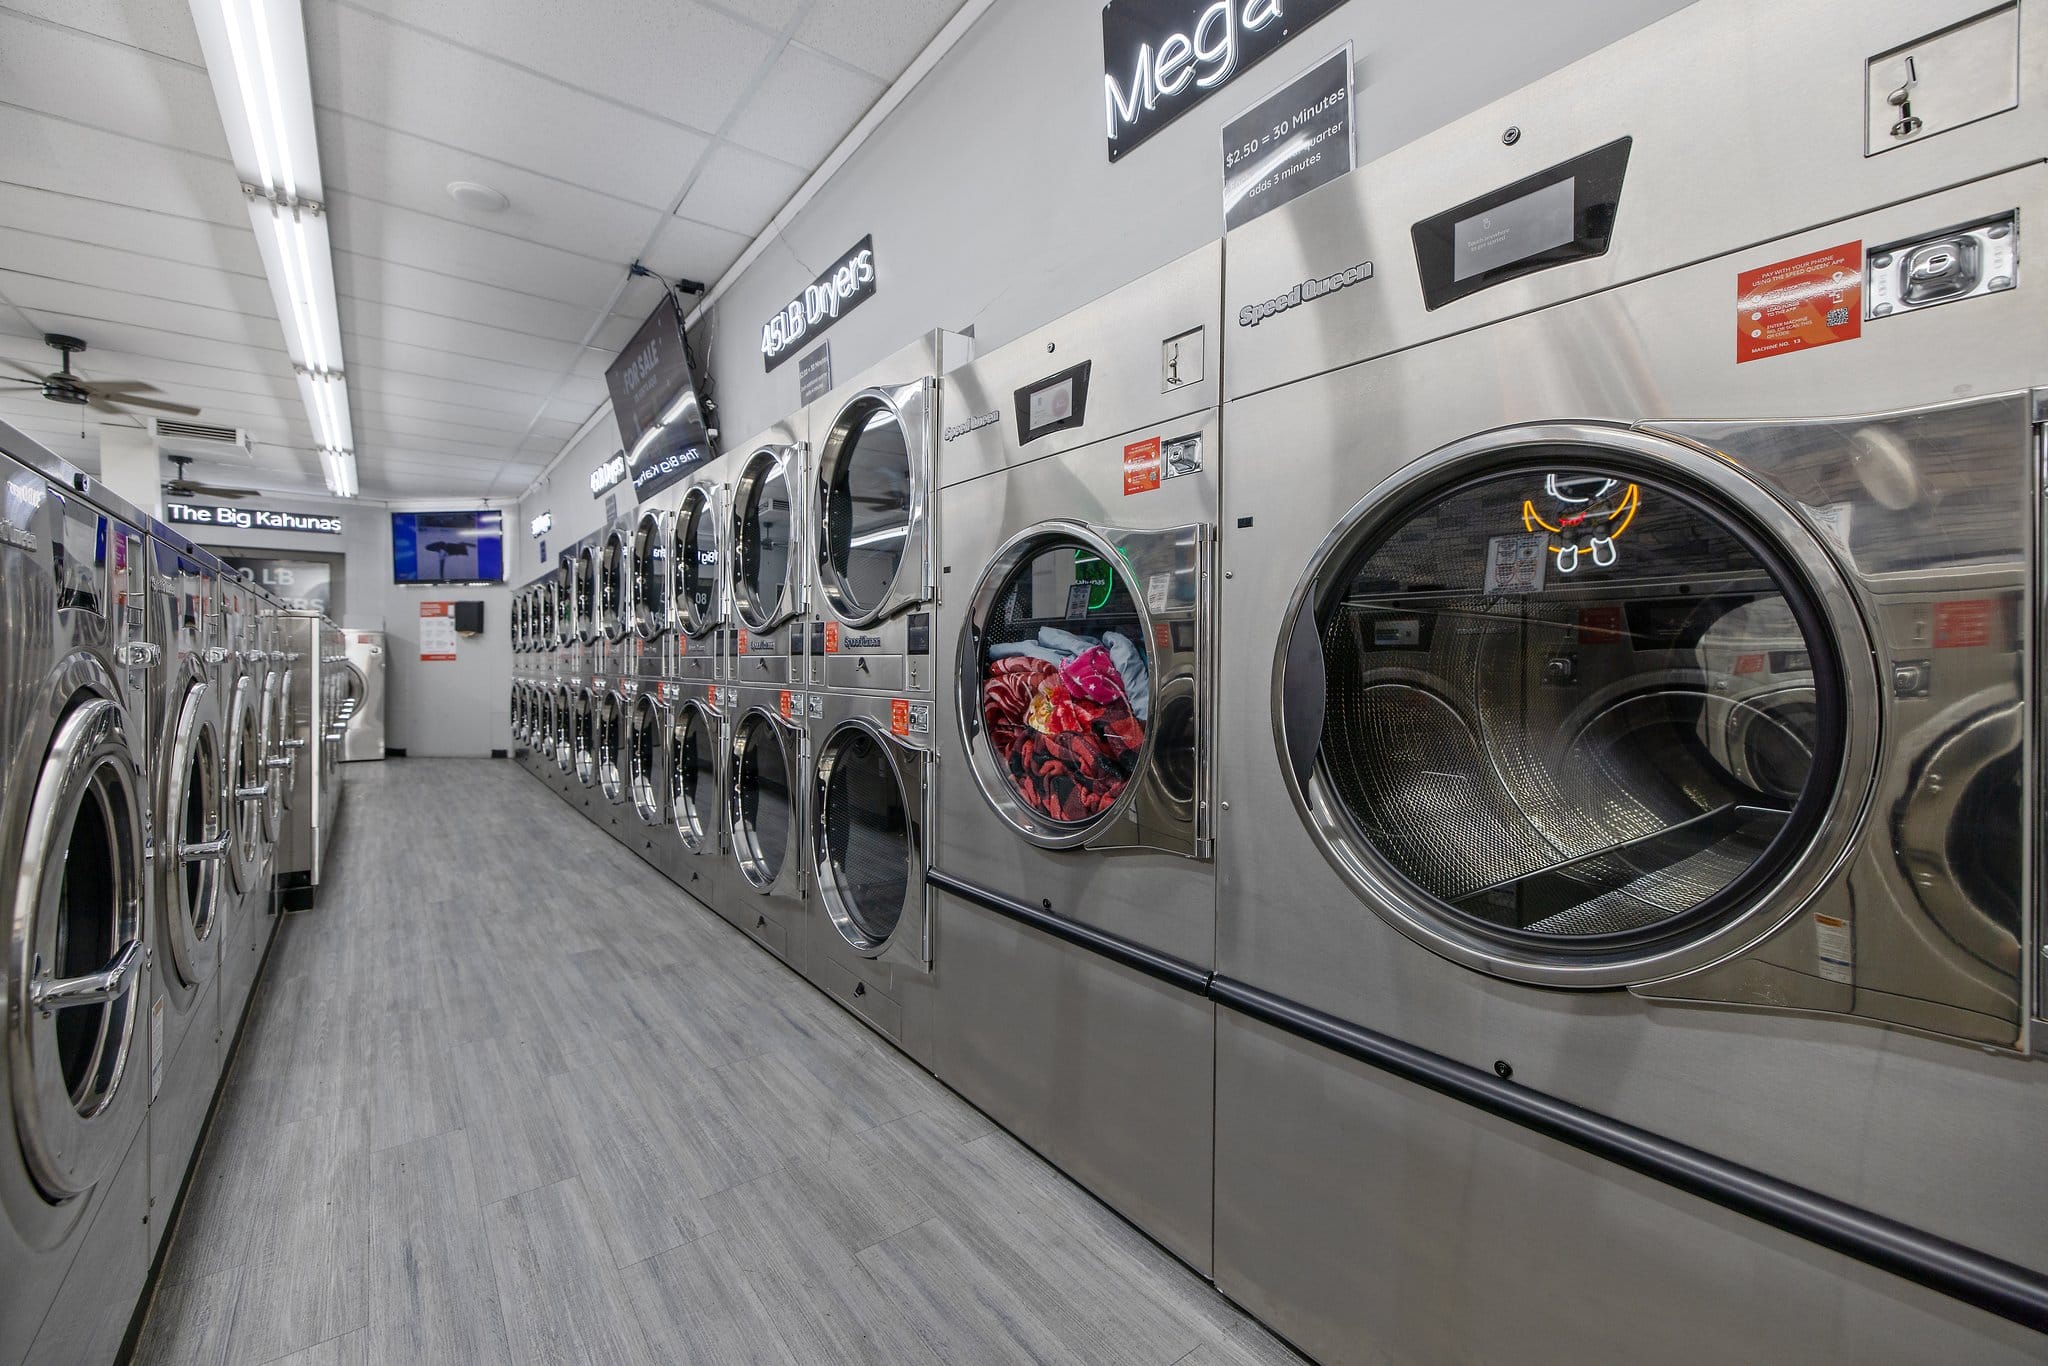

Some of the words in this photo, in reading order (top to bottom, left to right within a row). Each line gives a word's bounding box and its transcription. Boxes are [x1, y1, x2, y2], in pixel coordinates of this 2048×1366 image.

[1226, 139, 1259, 168] $2.50
[1261, 135, 1271, 144] =
[1273, 121, 1289, 140] 30
[1292, 88, 1345, 129] Minutes
[1249, 180, 1272, 198] adds
[1274, 173, 1280, 184] 3
[1281, 152, 1322, 182] minutes
[1752, 278, 1772, 287] USING
[1773, 274, 1785, 282] THE
[1785, 269, 1806, 279] SPEED
[1831, 258, 1845, 266] APP
[1761, 270, 1775, 279] PAY
[1775, 265, 1791, 276] WITH
[1791, 261, 1811, 272] YOUR
[1811, 254, 1834, 266] PHONE
[761, 301, 806, 357] 45LB
[804, 249, 875, 325] Dryers
[1239, 274, 1302, 327] Speed
[1301, 261, 1374, 302] Queen
[1751, 343, 1778, 353] MACHINE
[168, 503, 211, 522] The
[217, 507, 251, 529] Big
[256, 511, 342, 532] Kahunas
[238, 567, 254, 582] 0
[262, 568, 296, 586] LB
